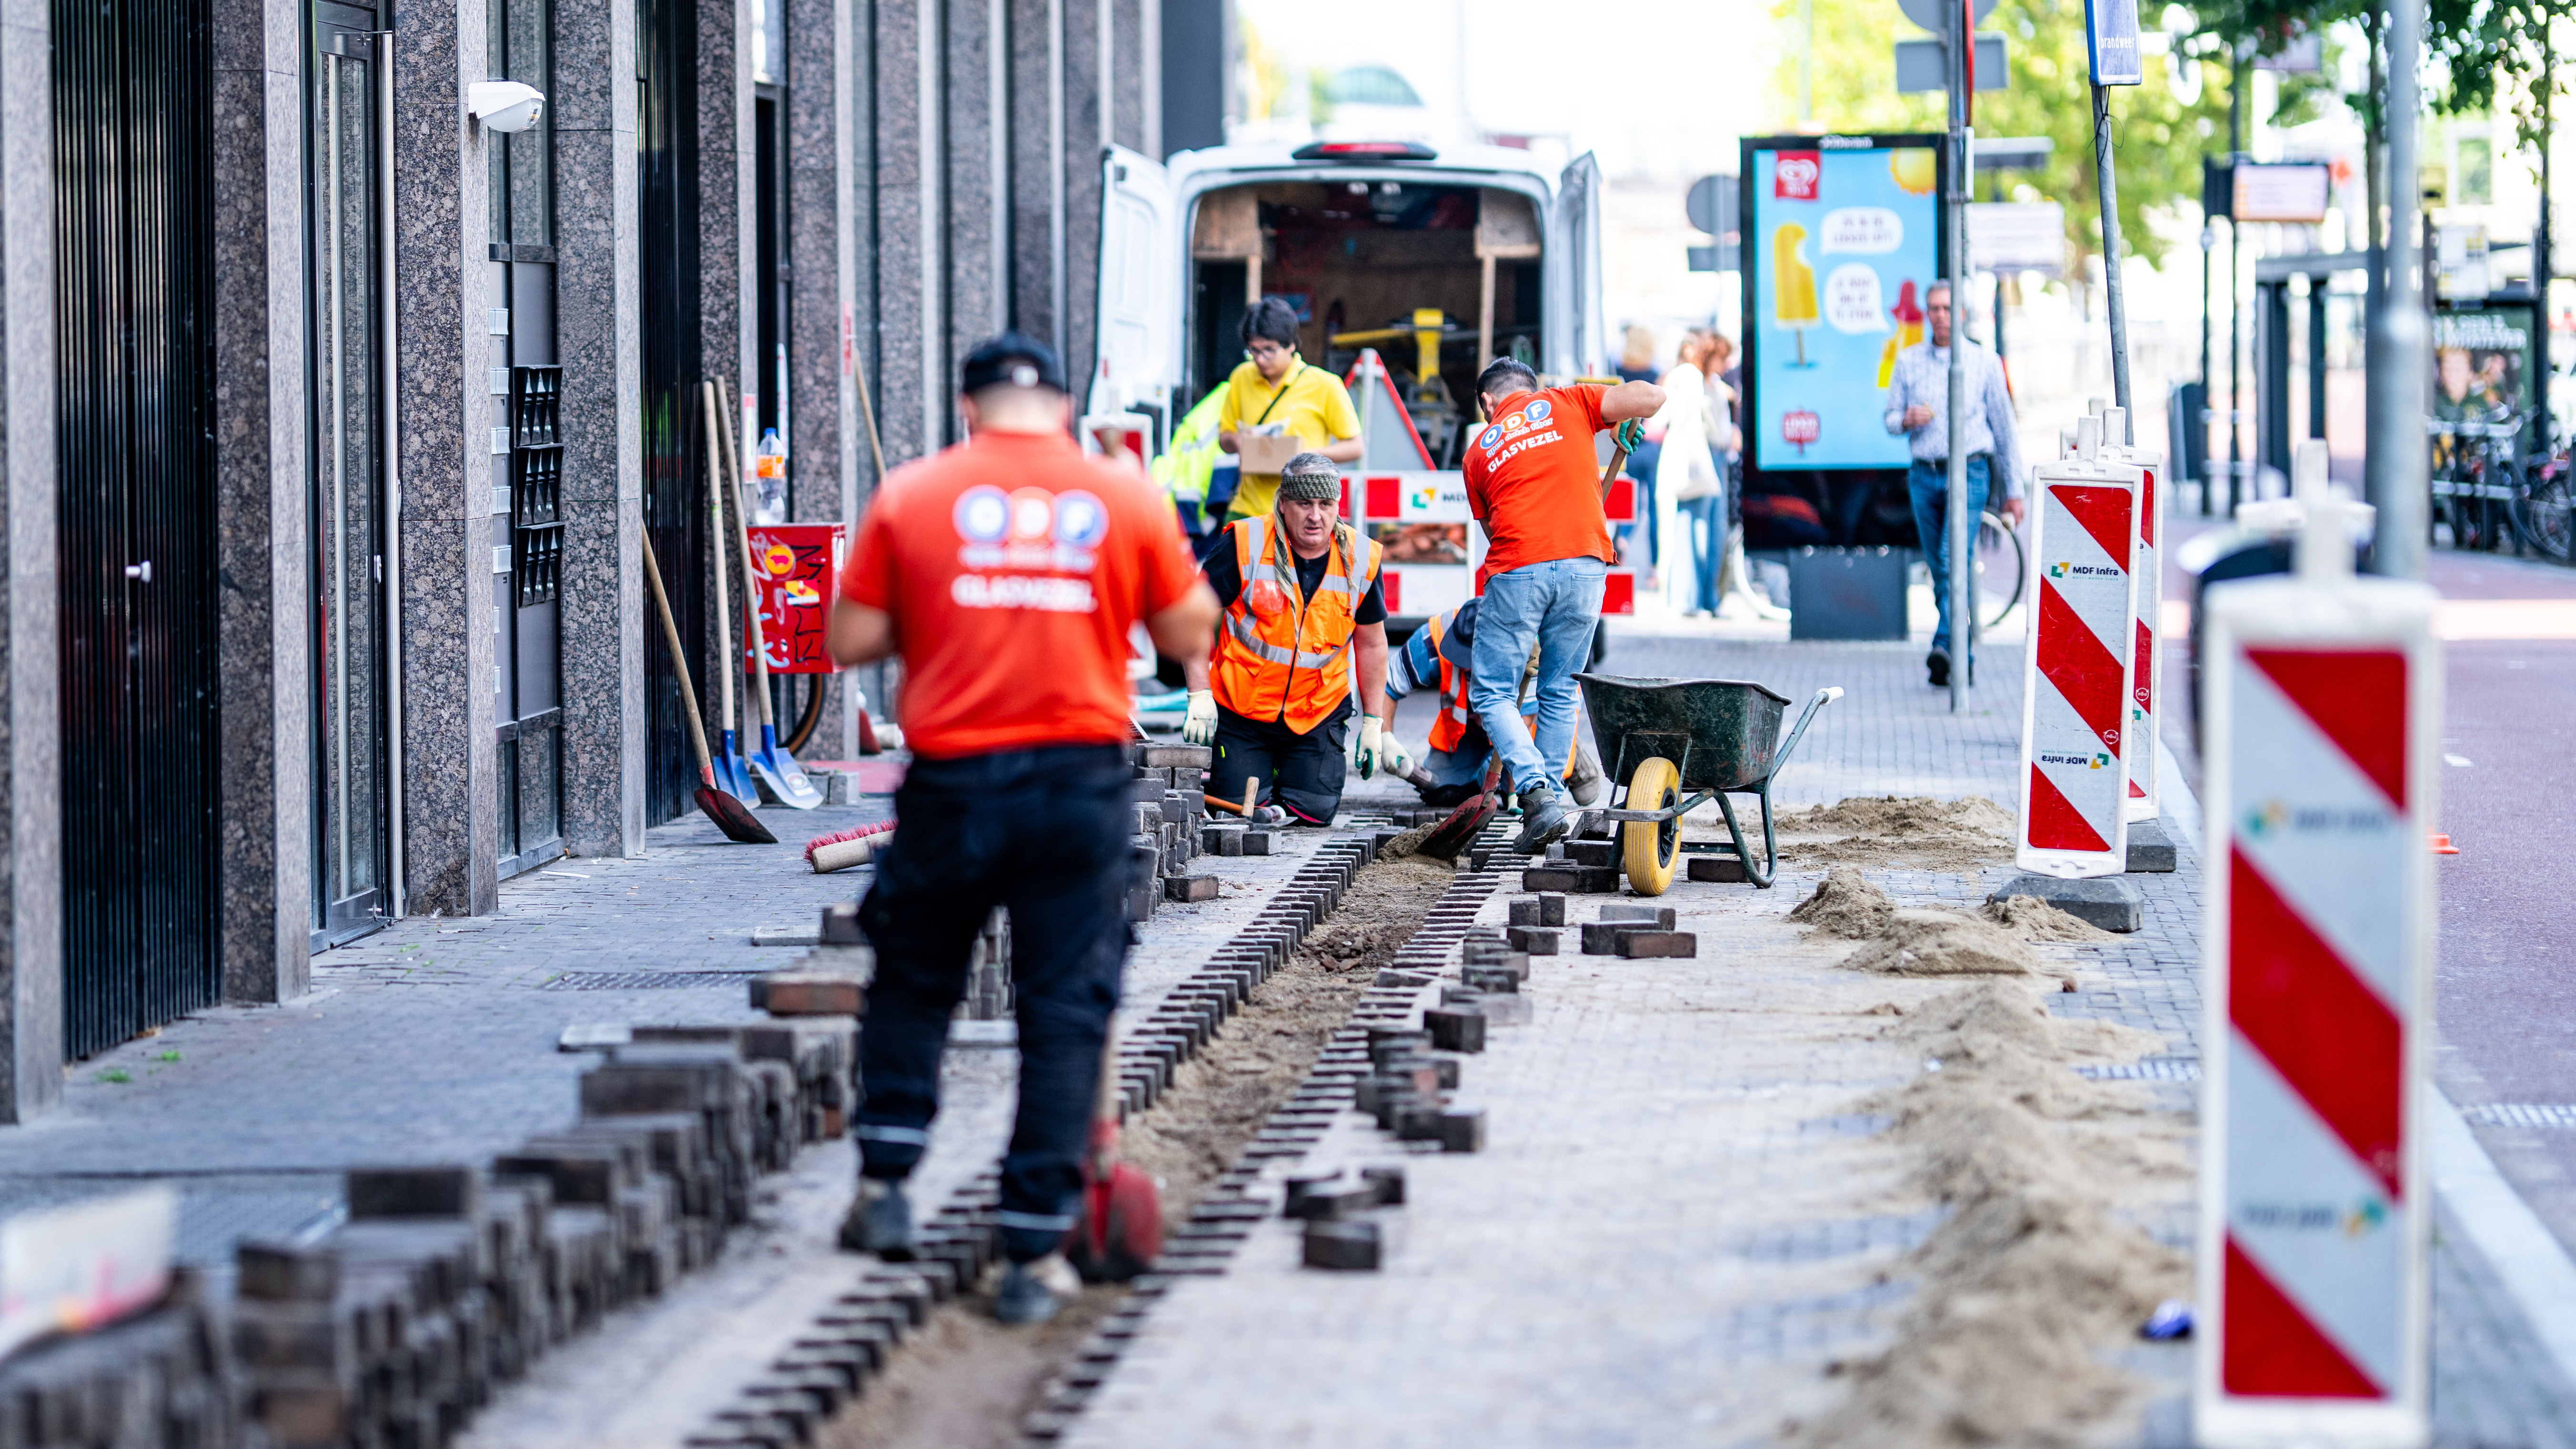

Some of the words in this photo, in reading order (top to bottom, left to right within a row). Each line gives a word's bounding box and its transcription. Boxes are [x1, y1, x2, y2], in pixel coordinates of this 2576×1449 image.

[2100, 34, 2135, 49] brandweer
[1483, 402, 1545, 445] ODF
[1486, 439, 1504, 458] open
[1505, 426, 1530, 441] dutch
[1531, 418, 1553, 430] fiber
[1488, 430, 1563, 473] GLASVEZEL
[1442, 492, 1468, 502] MD
[2073, 566, 2095, 574] MDF
[2096, 567, 2118, 575] Infra
[2042, 755, 2064, 764] Infra
[2066, 757, 2087, 765] MDF
